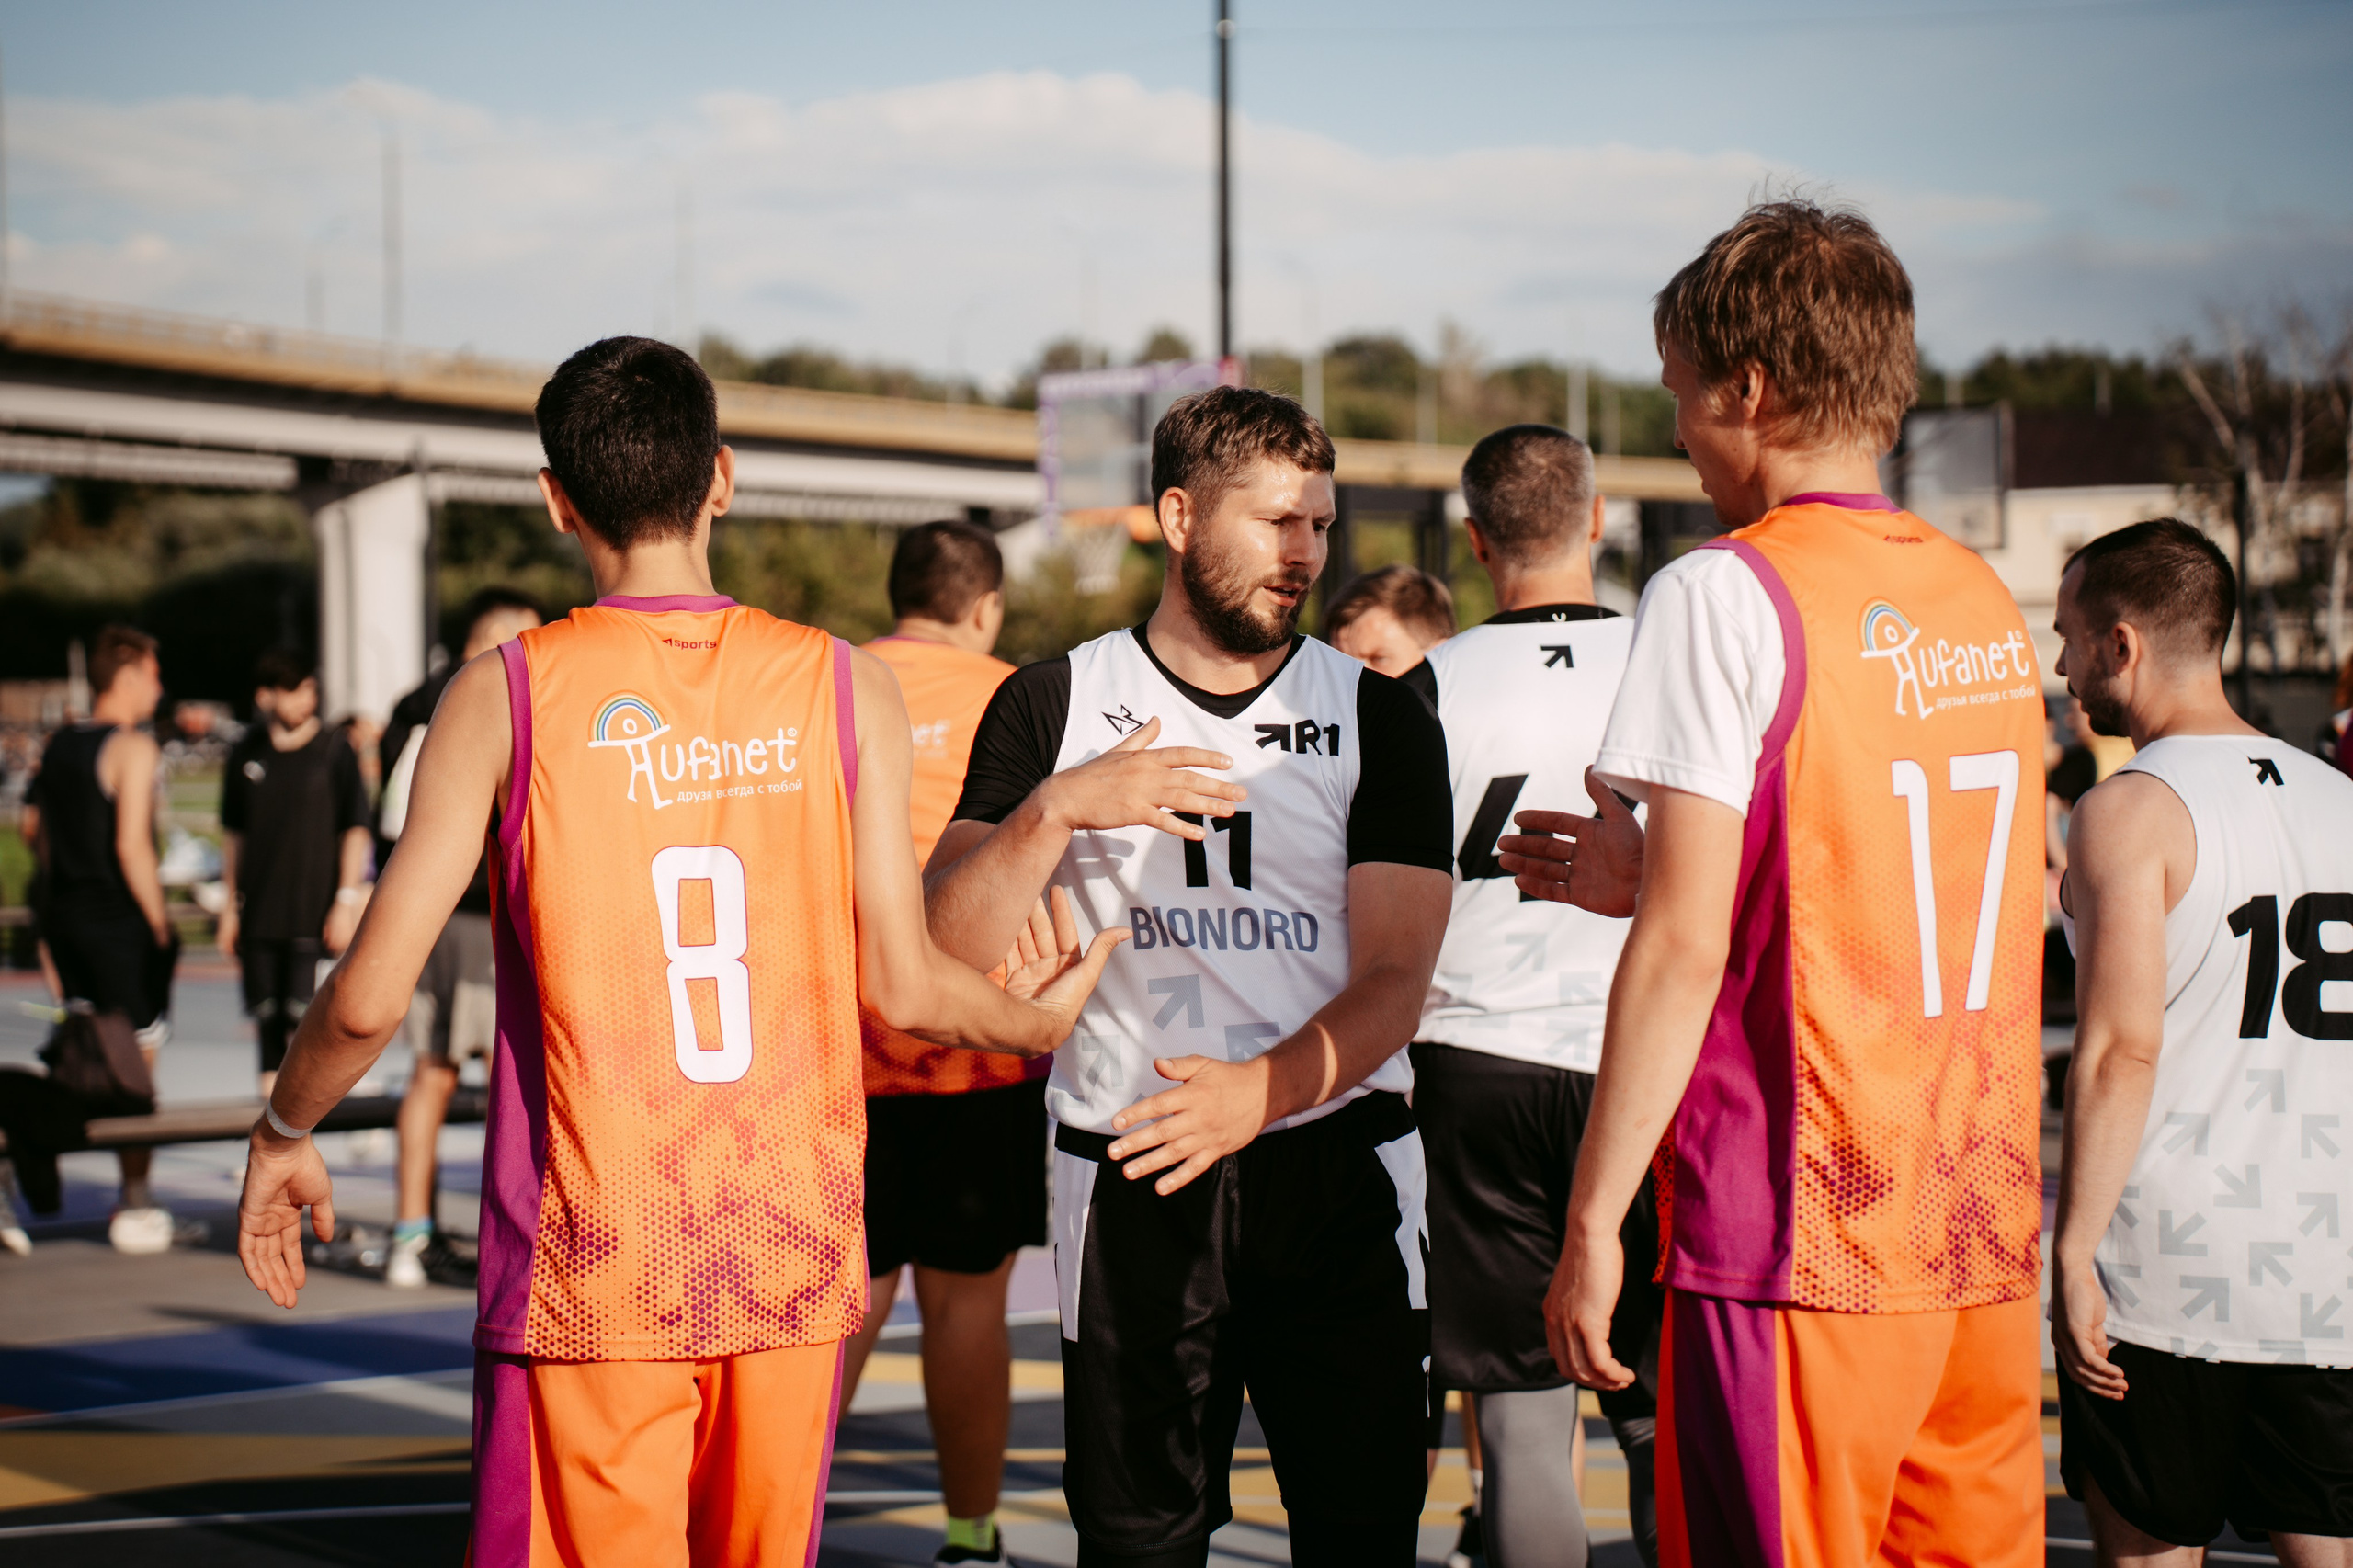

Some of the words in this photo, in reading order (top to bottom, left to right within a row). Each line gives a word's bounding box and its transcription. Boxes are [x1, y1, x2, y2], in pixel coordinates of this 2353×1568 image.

[1969, 691, 2001, 705] всегда
[2001, 690, 2008, 700] с
[2009, 684, 2036, 699] тобой
[677, 790, 712, 803] друзя
[716, 785, 755, 799] всегда
[757, 784, 765, 794] с
[767, 778, 802, 794] тобой
[1170, 811, 1252, 891] 11
[1891, 749, 2020, 1018] 17
[650, 845, 754, 1084] 8
[1129, 906, 1319, 953] BIONORD
[2227, 892, 2353, 1040] 18
